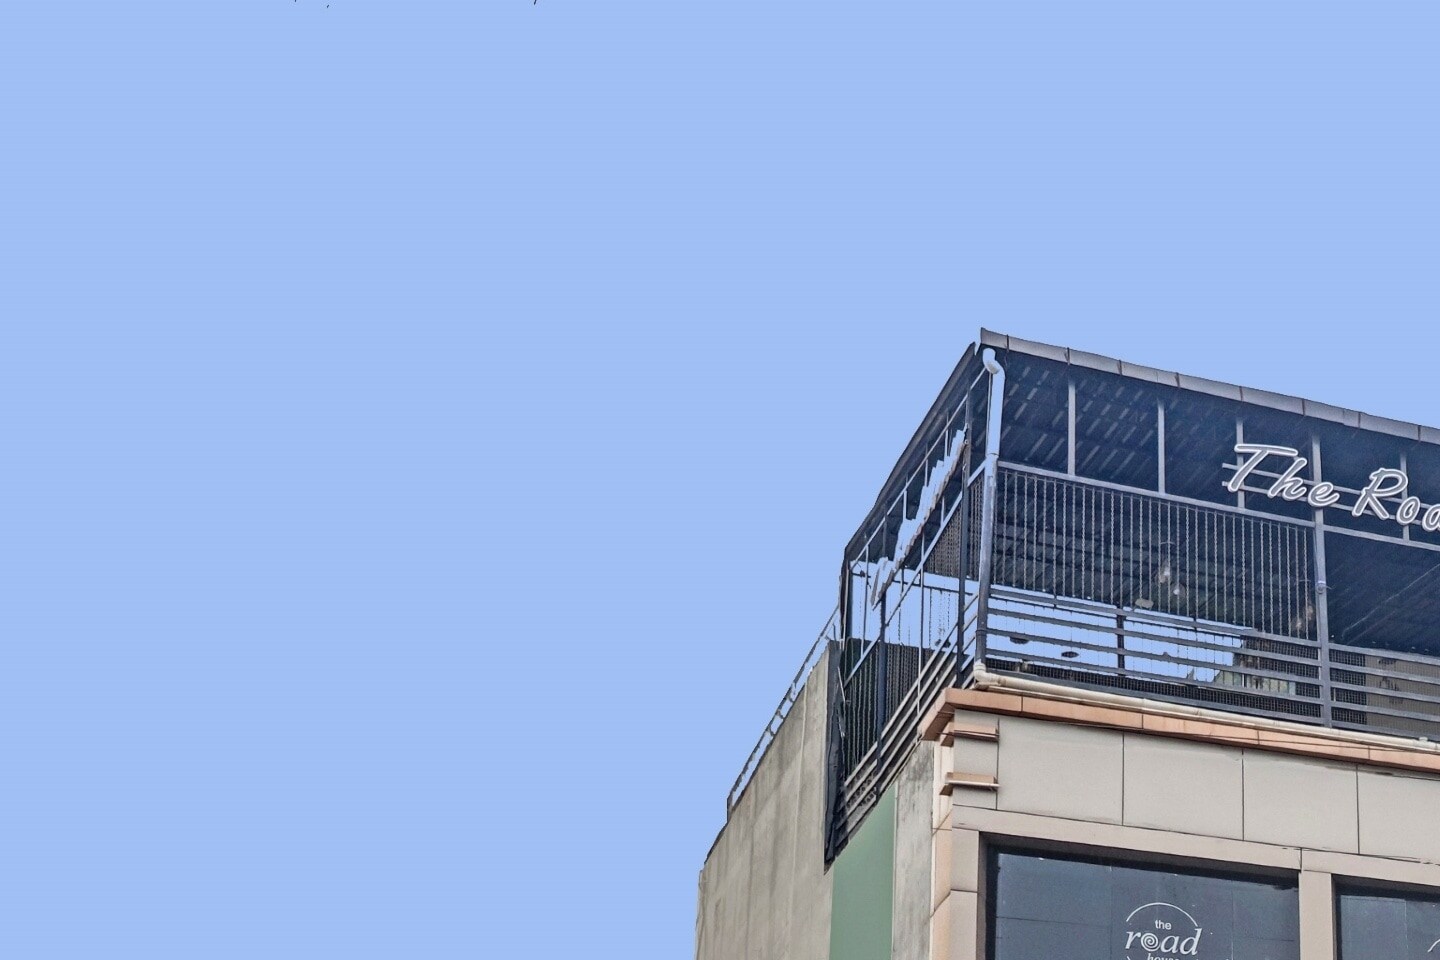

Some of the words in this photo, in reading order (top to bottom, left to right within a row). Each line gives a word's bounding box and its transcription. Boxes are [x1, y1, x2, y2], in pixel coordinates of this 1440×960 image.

[1226, 443, 1340, 508] The
[1154, 919, 1172, 930] the
[1125, 928, 1202, 955] road
